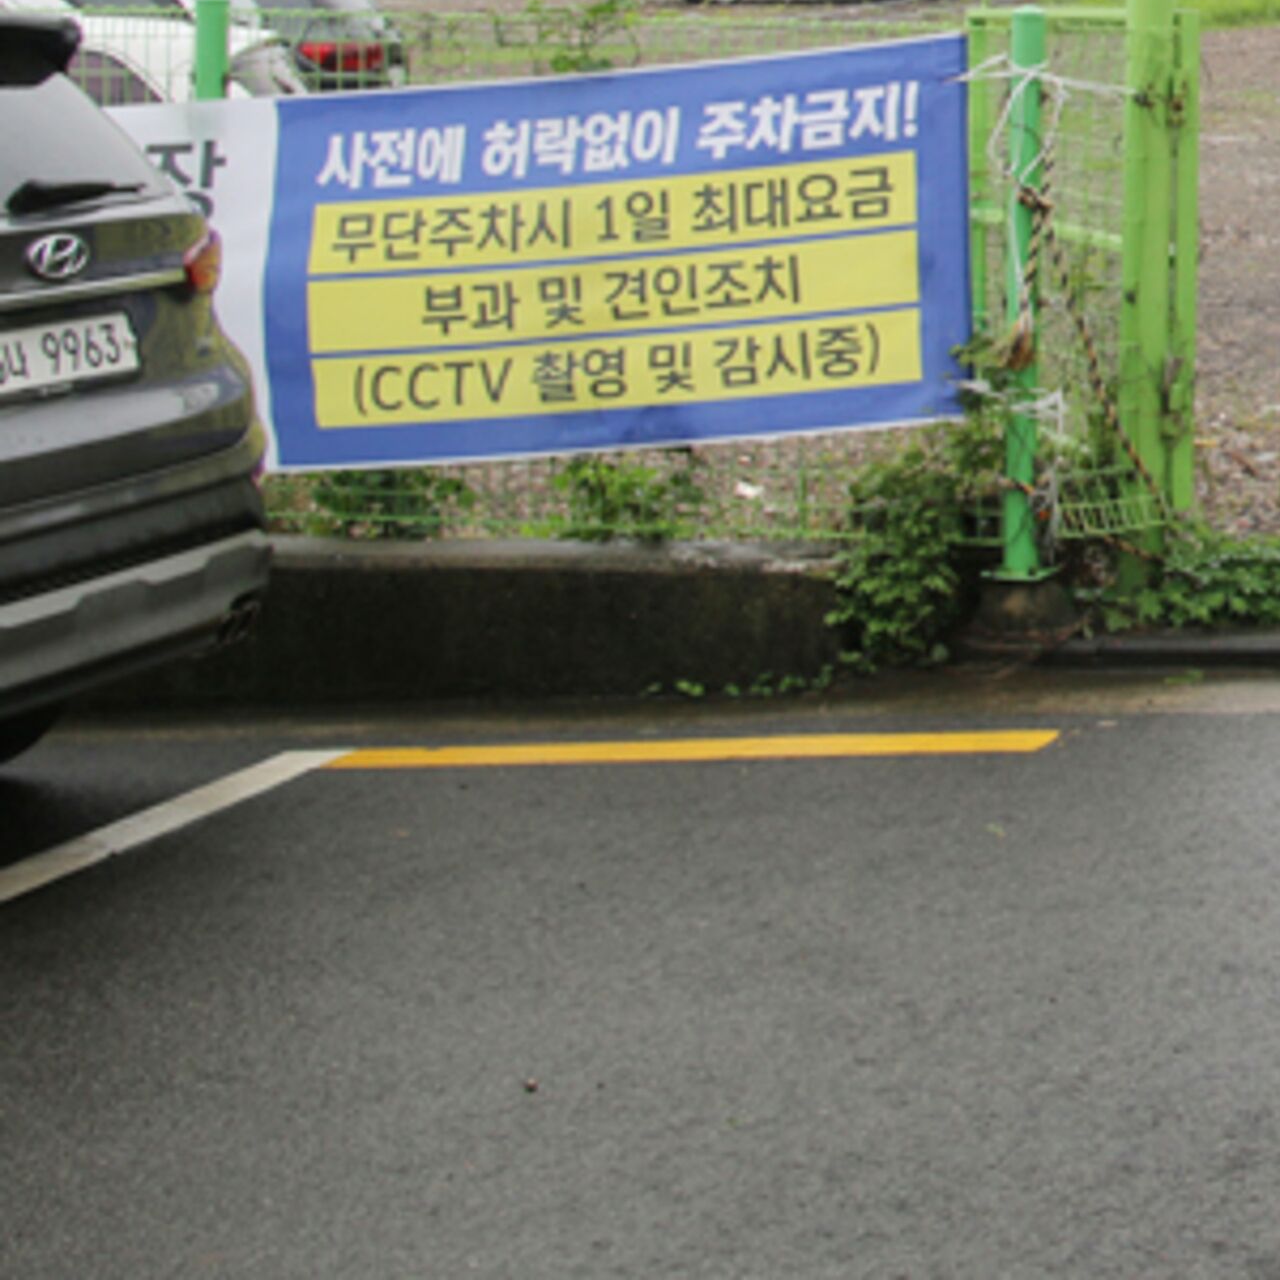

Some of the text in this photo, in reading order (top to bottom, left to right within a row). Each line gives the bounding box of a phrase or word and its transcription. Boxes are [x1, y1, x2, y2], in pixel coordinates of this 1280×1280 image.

[316, 80, 919, 189] 사전에 허락없이 주차금지!
[332, 166, 894, 263] 무단주차시 1일 최대요금
[422, 254, 799, 336] 부과 및 견인조치
[41, 323, 121, 375] 9963
[354, 322, 880, 416] (CCTV 촬영 및 감시중)
